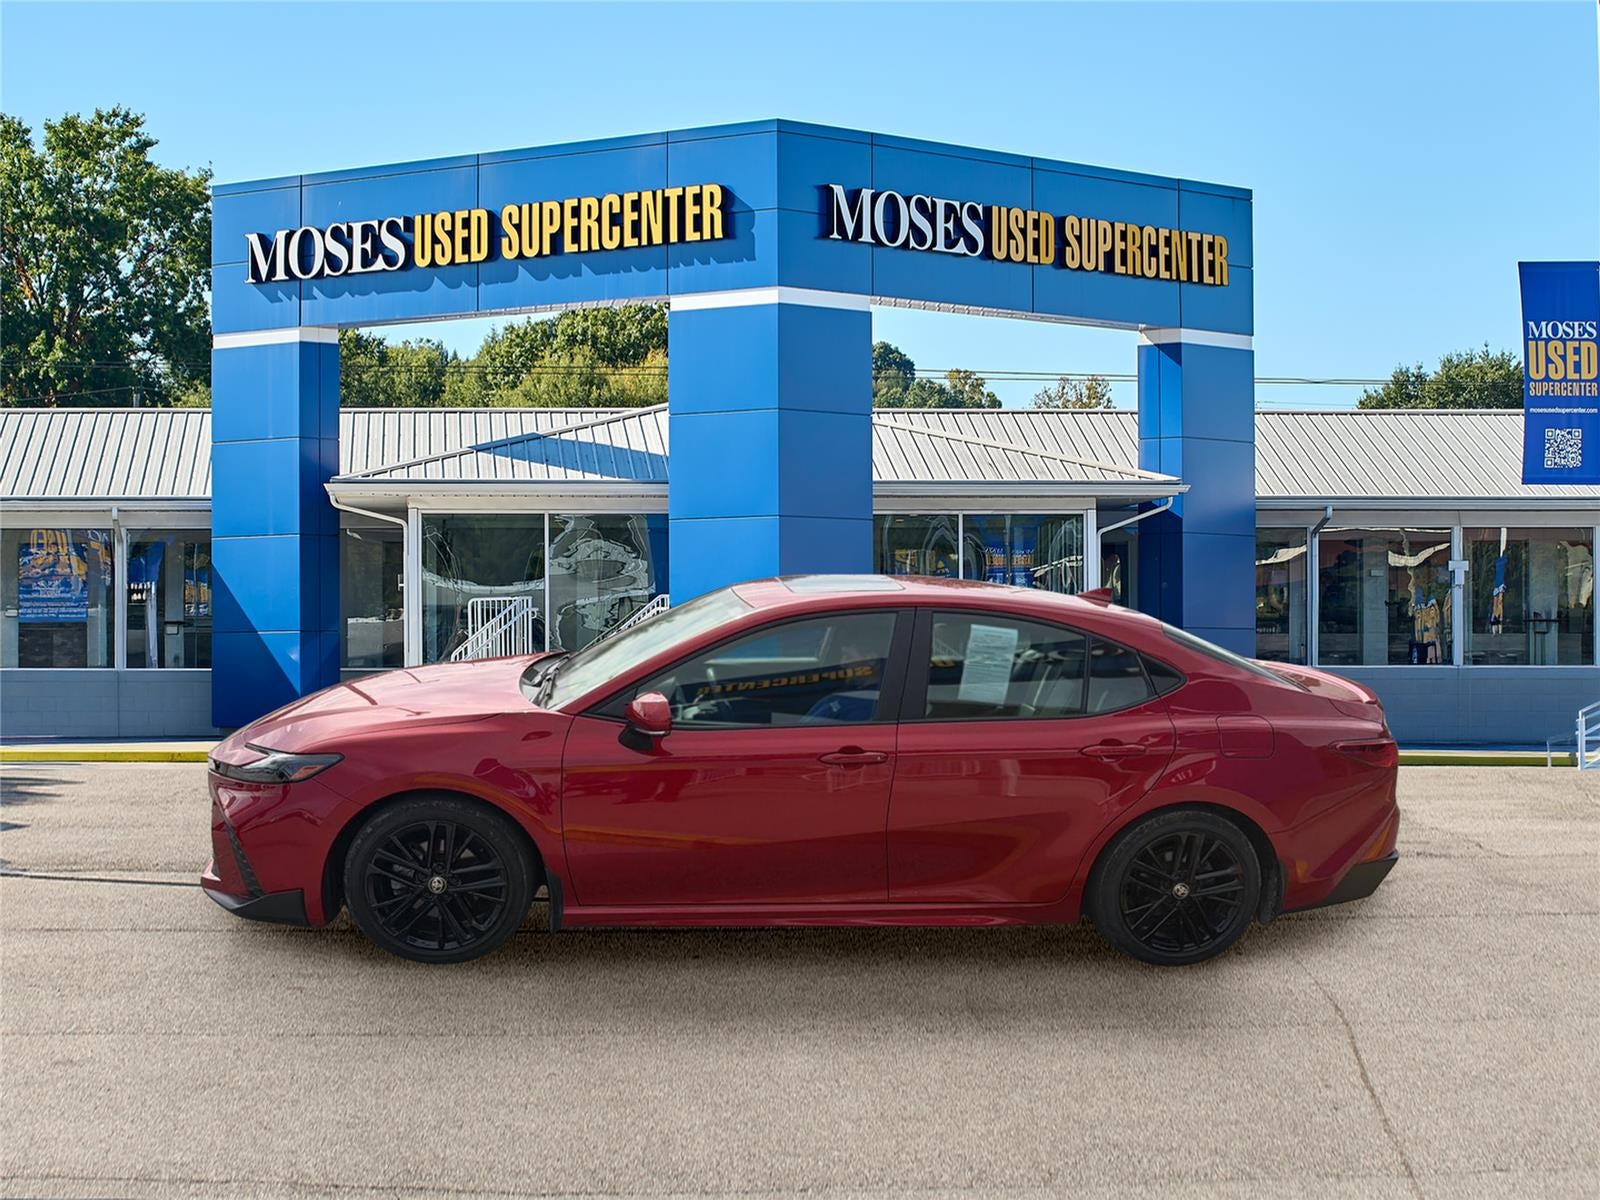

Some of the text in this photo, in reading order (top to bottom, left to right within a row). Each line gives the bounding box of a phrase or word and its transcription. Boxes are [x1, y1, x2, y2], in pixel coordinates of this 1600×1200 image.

[244, 183, 724, 284] MOSES USED SUPERCENTER
[829, 184, 1229, 286] MOSES USED SUPERCENTER
[1528, 321, 1597, 339] MOSES
[1528, 340, 1598, 380] USED
[1529, 382, 1598, 397] SUPERCENTER
